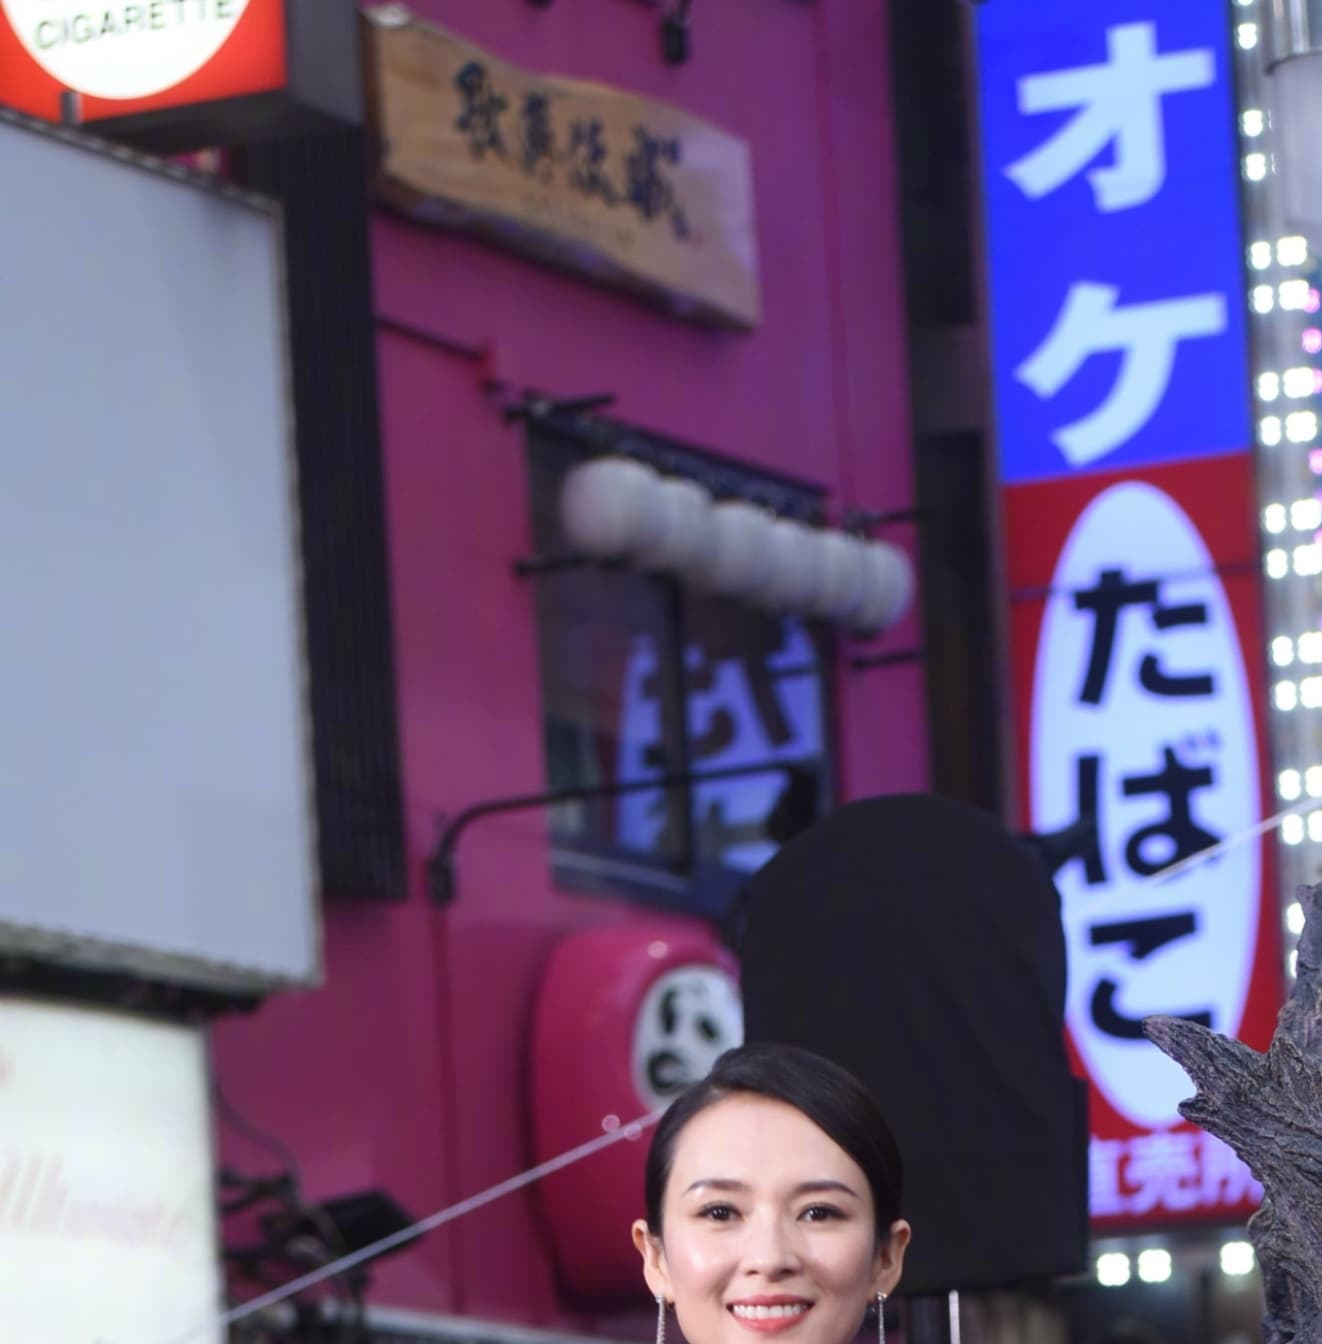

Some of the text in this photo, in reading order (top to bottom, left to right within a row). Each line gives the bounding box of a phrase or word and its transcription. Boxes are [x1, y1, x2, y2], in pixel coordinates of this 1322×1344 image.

[1003, 20, 1229, 469] オケ
[1073, 567, 1222, 1040] たばこ
